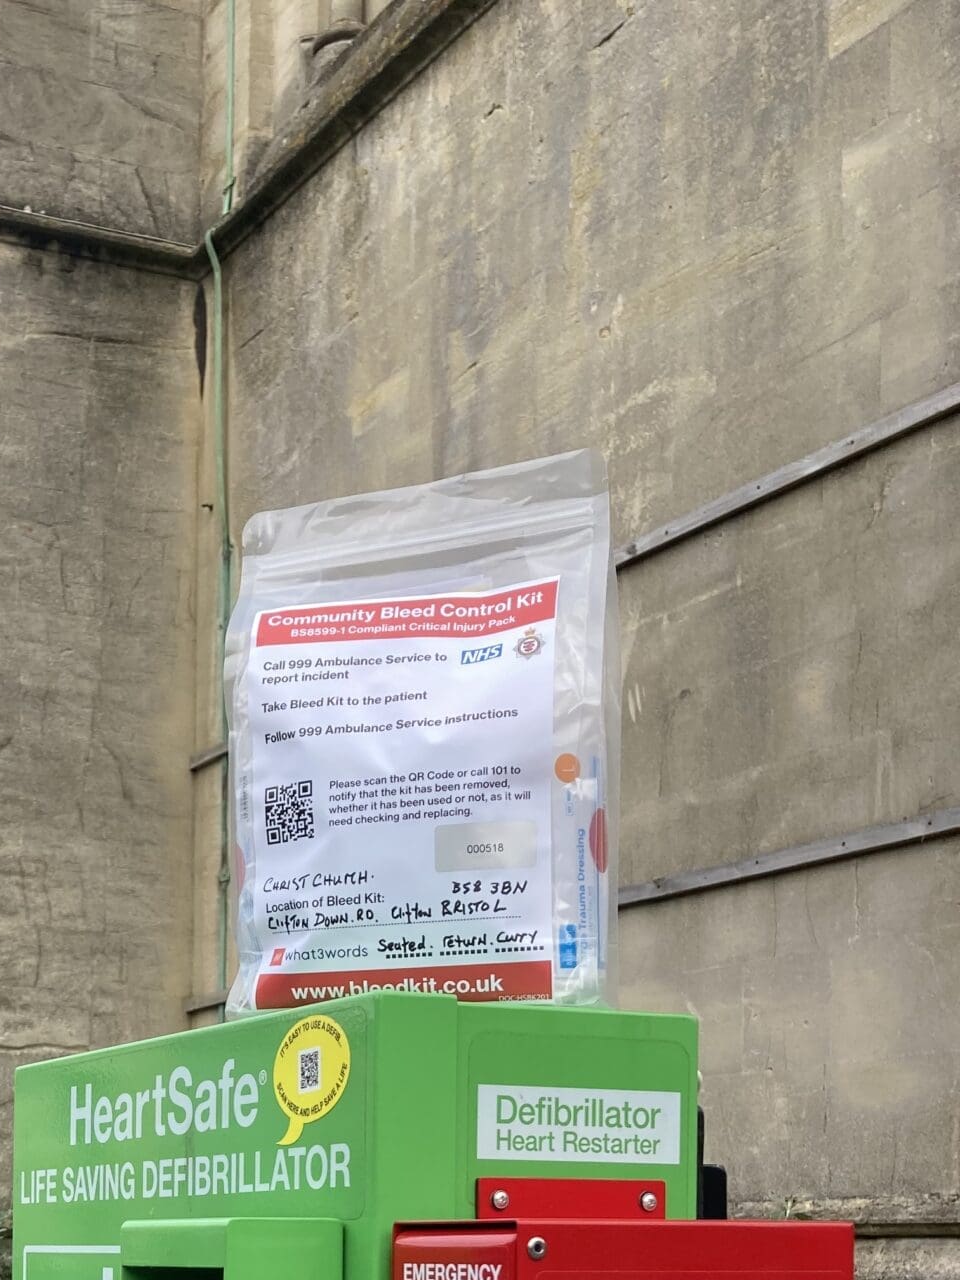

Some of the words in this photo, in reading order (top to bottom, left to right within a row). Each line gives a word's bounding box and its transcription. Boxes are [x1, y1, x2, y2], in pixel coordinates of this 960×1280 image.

[268, 609, 376, 626] Community
[380, 603, 435, 619] Bleed
[440, 597, 512, 618] Control
[516, 591, 544, 608] Kit
[290, 626, 346, 637] BS8599-1
[348, 622, 406, 635] Compliant
[409, 621, 450, 631] Critical
[453, 621, 486, 633] Injury
[489, 615, 516, 628] Pack
[263, 659, 286, 671] Call
[288, 658, 313, 669] 999
[315, 655, 382, 668] Ambulance
[385, 653, 432, 664] Service
[462, 645, 501, 664] NHS
[262, 672, 298, 684] report
[302, 671, 349, 681] incident
[262, 702, 287, 713] Take
[290, 697, 324, 709] Bleed
[327, 696, 343, 706] Kit
[384, 691, 427, 705] patient
[265, 731, 295, 744] Follow
[299, 727, 322, 737] 999
[325, 724, 392, 734] Ambulance
[396, 718, 441, 729] Service
[445, 709, 518, 725] instructions
[329, 780, 361, 789] Please
[427, 770, 454, 780] Code
[471, 767, 488, 776] call
[491, 766, 507, 774] 101
[329, 791, 356, 802] notify
[435, 783, 460, 792] been
[463, 779, 510, 789] removed,
[329, 804, 367, 814] whether
[400, 798, 425, 808] been
[427, 796, 452, 805] used
[468, 793, 488, 803] not,
[514, 791, 531, 800] will
[329, 817, 352, 827] need
[355, 812, 399, 824] checking
[423, 807, 472, 819] replacing.
[467, 843, 504, 853] 000518
[490, 880, 527, 894] 3BN
[266, 898, 308, 913] Location
[327, 895, 361, 906] Bleed
[365, 893, 384, 904] Kit:
[441, 899, 507, 917] BRISTOL
[578, 890, 586, 930] Trauma
[285, 946, 368, 960] what3words
[288, 1026, 301, 1044] EASY
[311, 1021, 320, 1029] USE
[311, 1102, 323, 1114] HELP
[324, 1089, 337, 1106] SAVE
[496, 1095, 661, 1129] Defibrillator
[496, 1129, 555, 1152] Heart
[563, 1131, 660, 1155] Restarter
[20, 1169, 57, 1204] LIFE
[62, 1162, 135, 1203] SAVING
[143, 1143, 351, 1199] DEFIBRILLATOR
